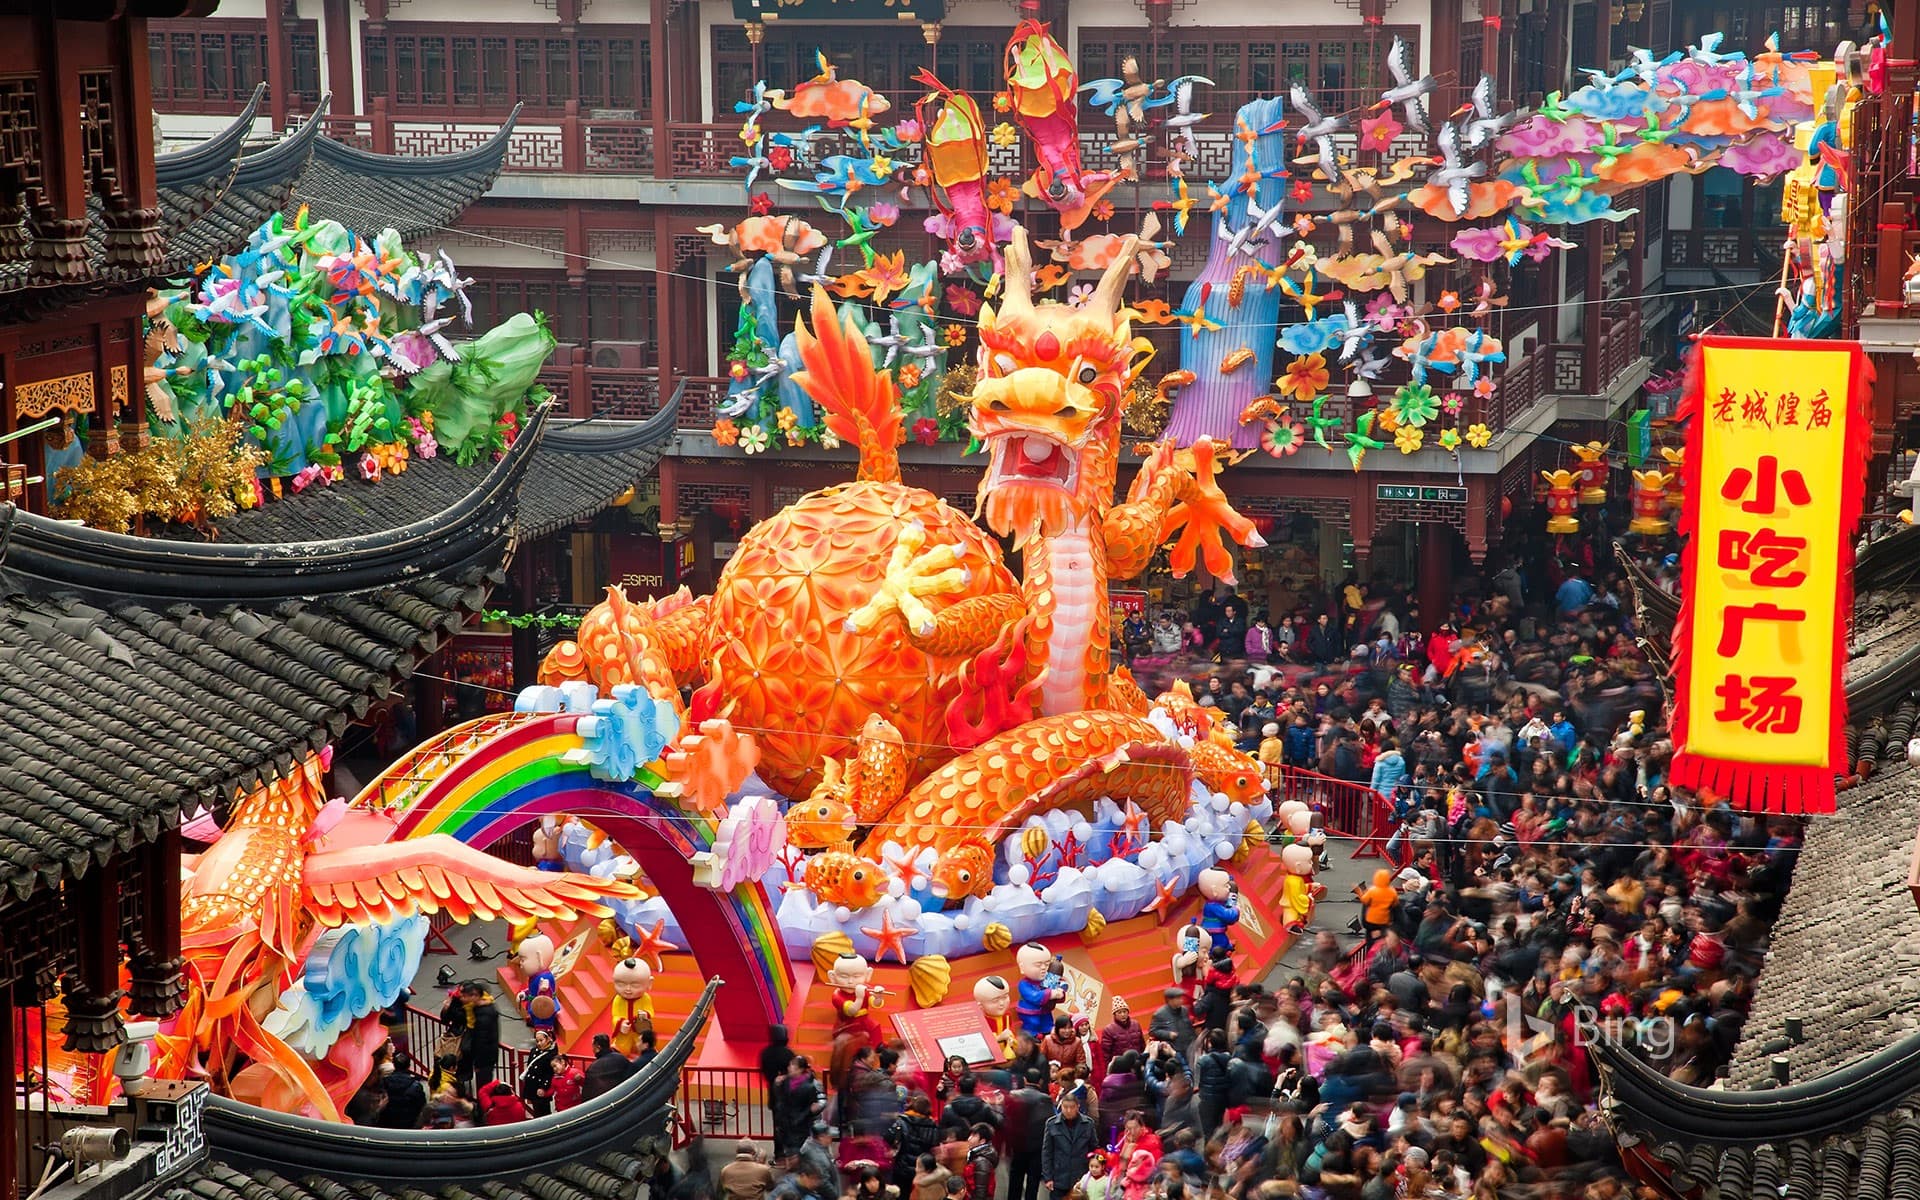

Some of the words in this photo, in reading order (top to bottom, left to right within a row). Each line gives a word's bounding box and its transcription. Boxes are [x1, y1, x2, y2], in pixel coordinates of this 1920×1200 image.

[1712, 387, 1832, 431] 老城隍庙
[622, 573, 663, 588] ESPRIT
[1714, 455, 1812, 734] 小吃广场
